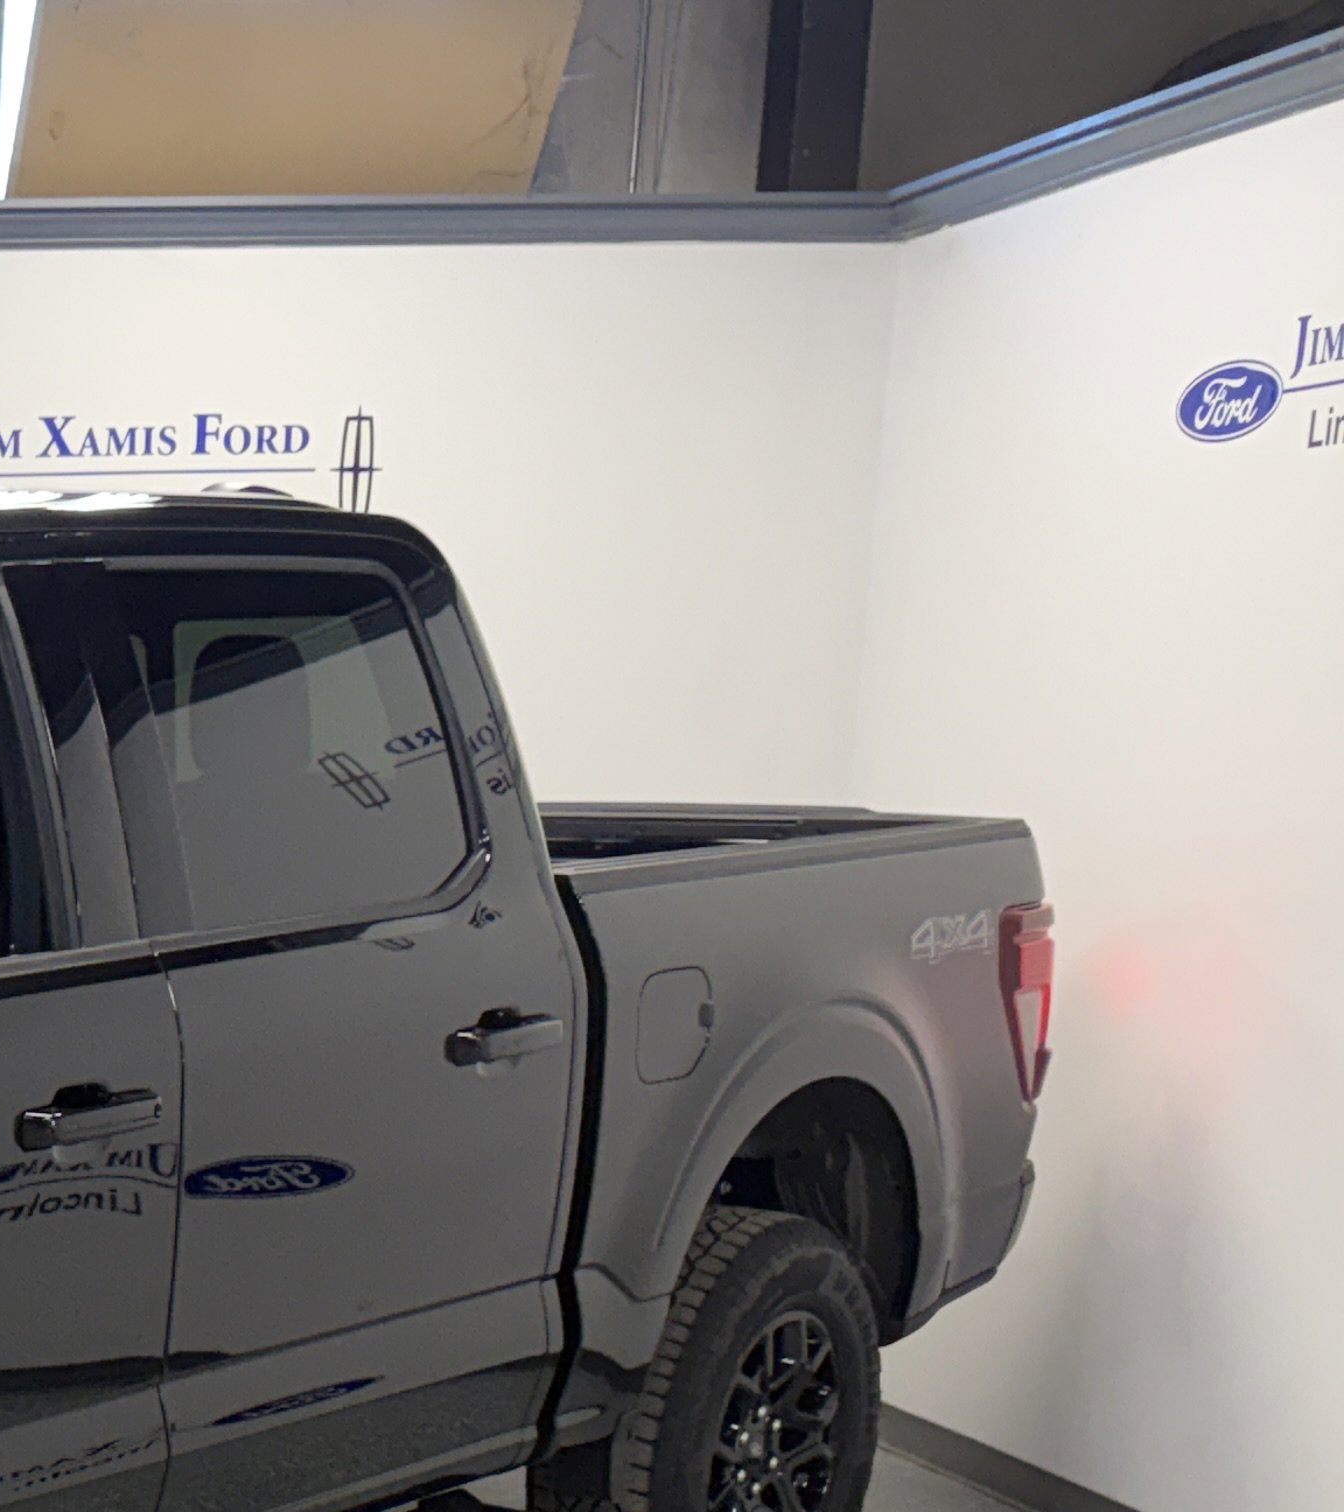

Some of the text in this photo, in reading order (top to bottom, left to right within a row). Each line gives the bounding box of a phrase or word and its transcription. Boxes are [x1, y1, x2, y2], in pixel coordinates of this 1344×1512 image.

[1194, 375, 1263, 431] Ford
[36, 414, 178, 459] XAMIS
[190, 412, 311, 457] FORD
